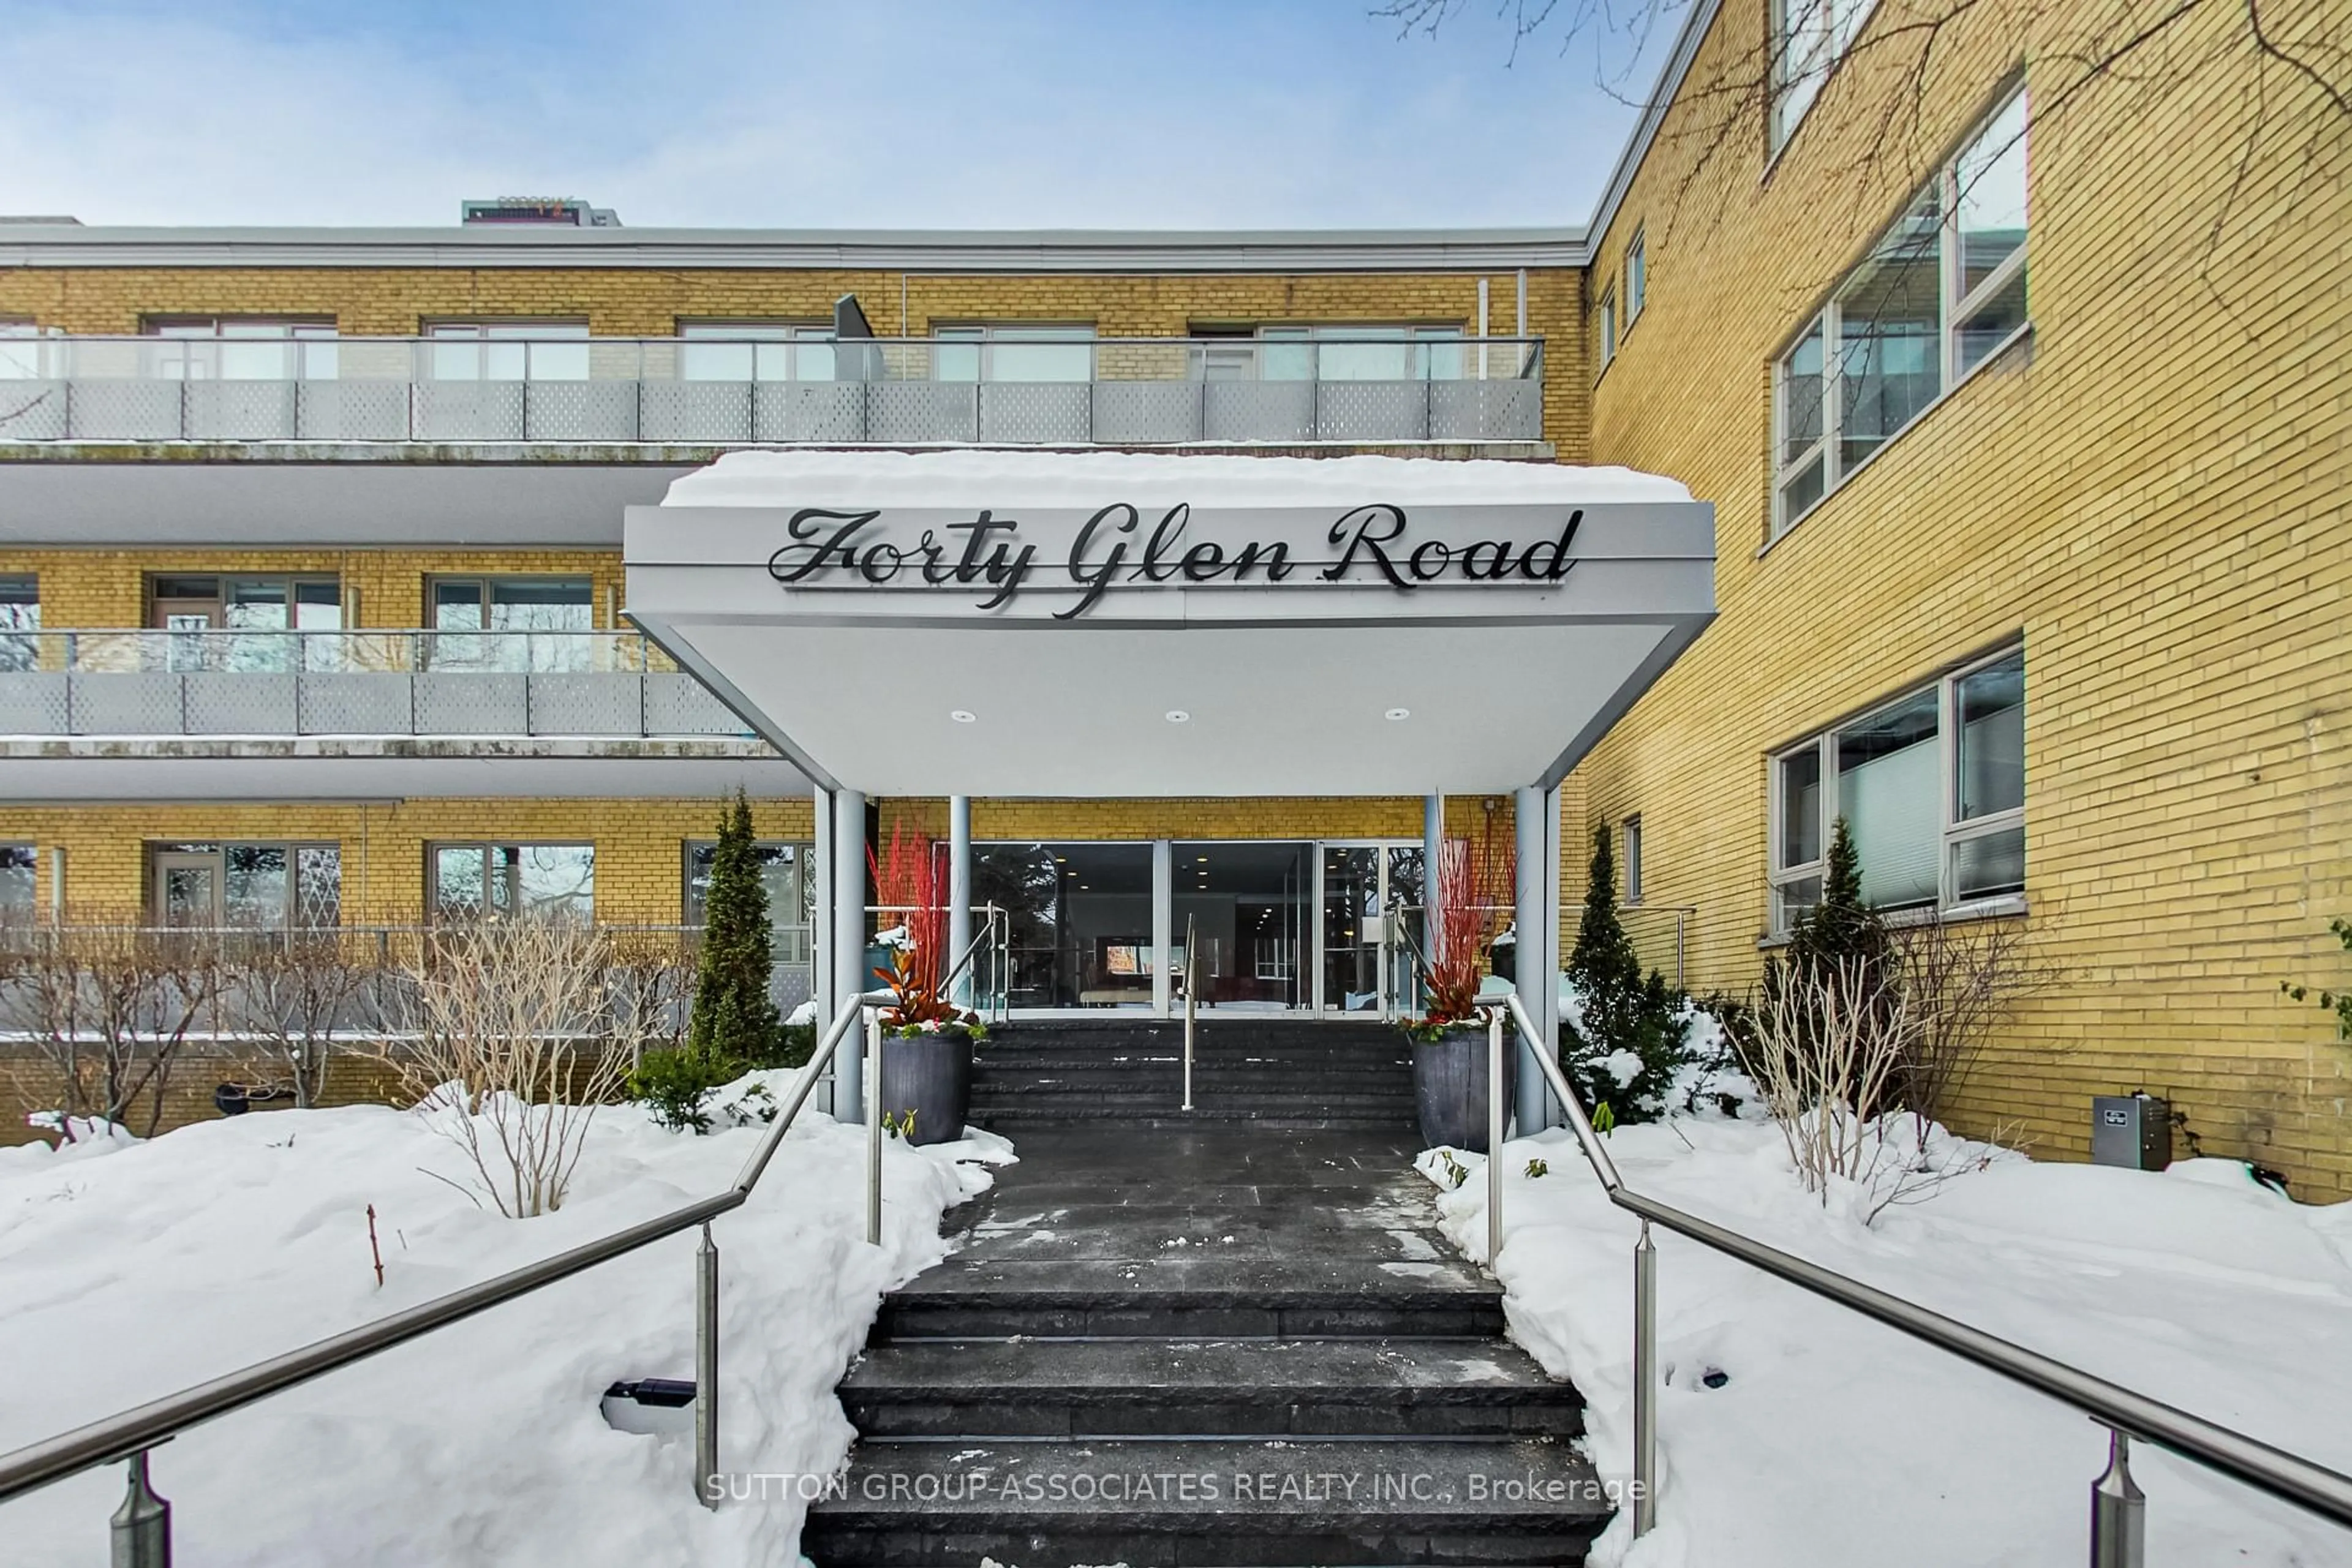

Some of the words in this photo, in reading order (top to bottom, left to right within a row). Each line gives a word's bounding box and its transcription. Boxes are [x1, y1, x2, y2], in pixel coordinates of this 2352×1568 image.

[768, 508, 1036, 609] Forty
[1051, 502, 1295, 620] Glen
[1322, 503, 1584, 589] Road
